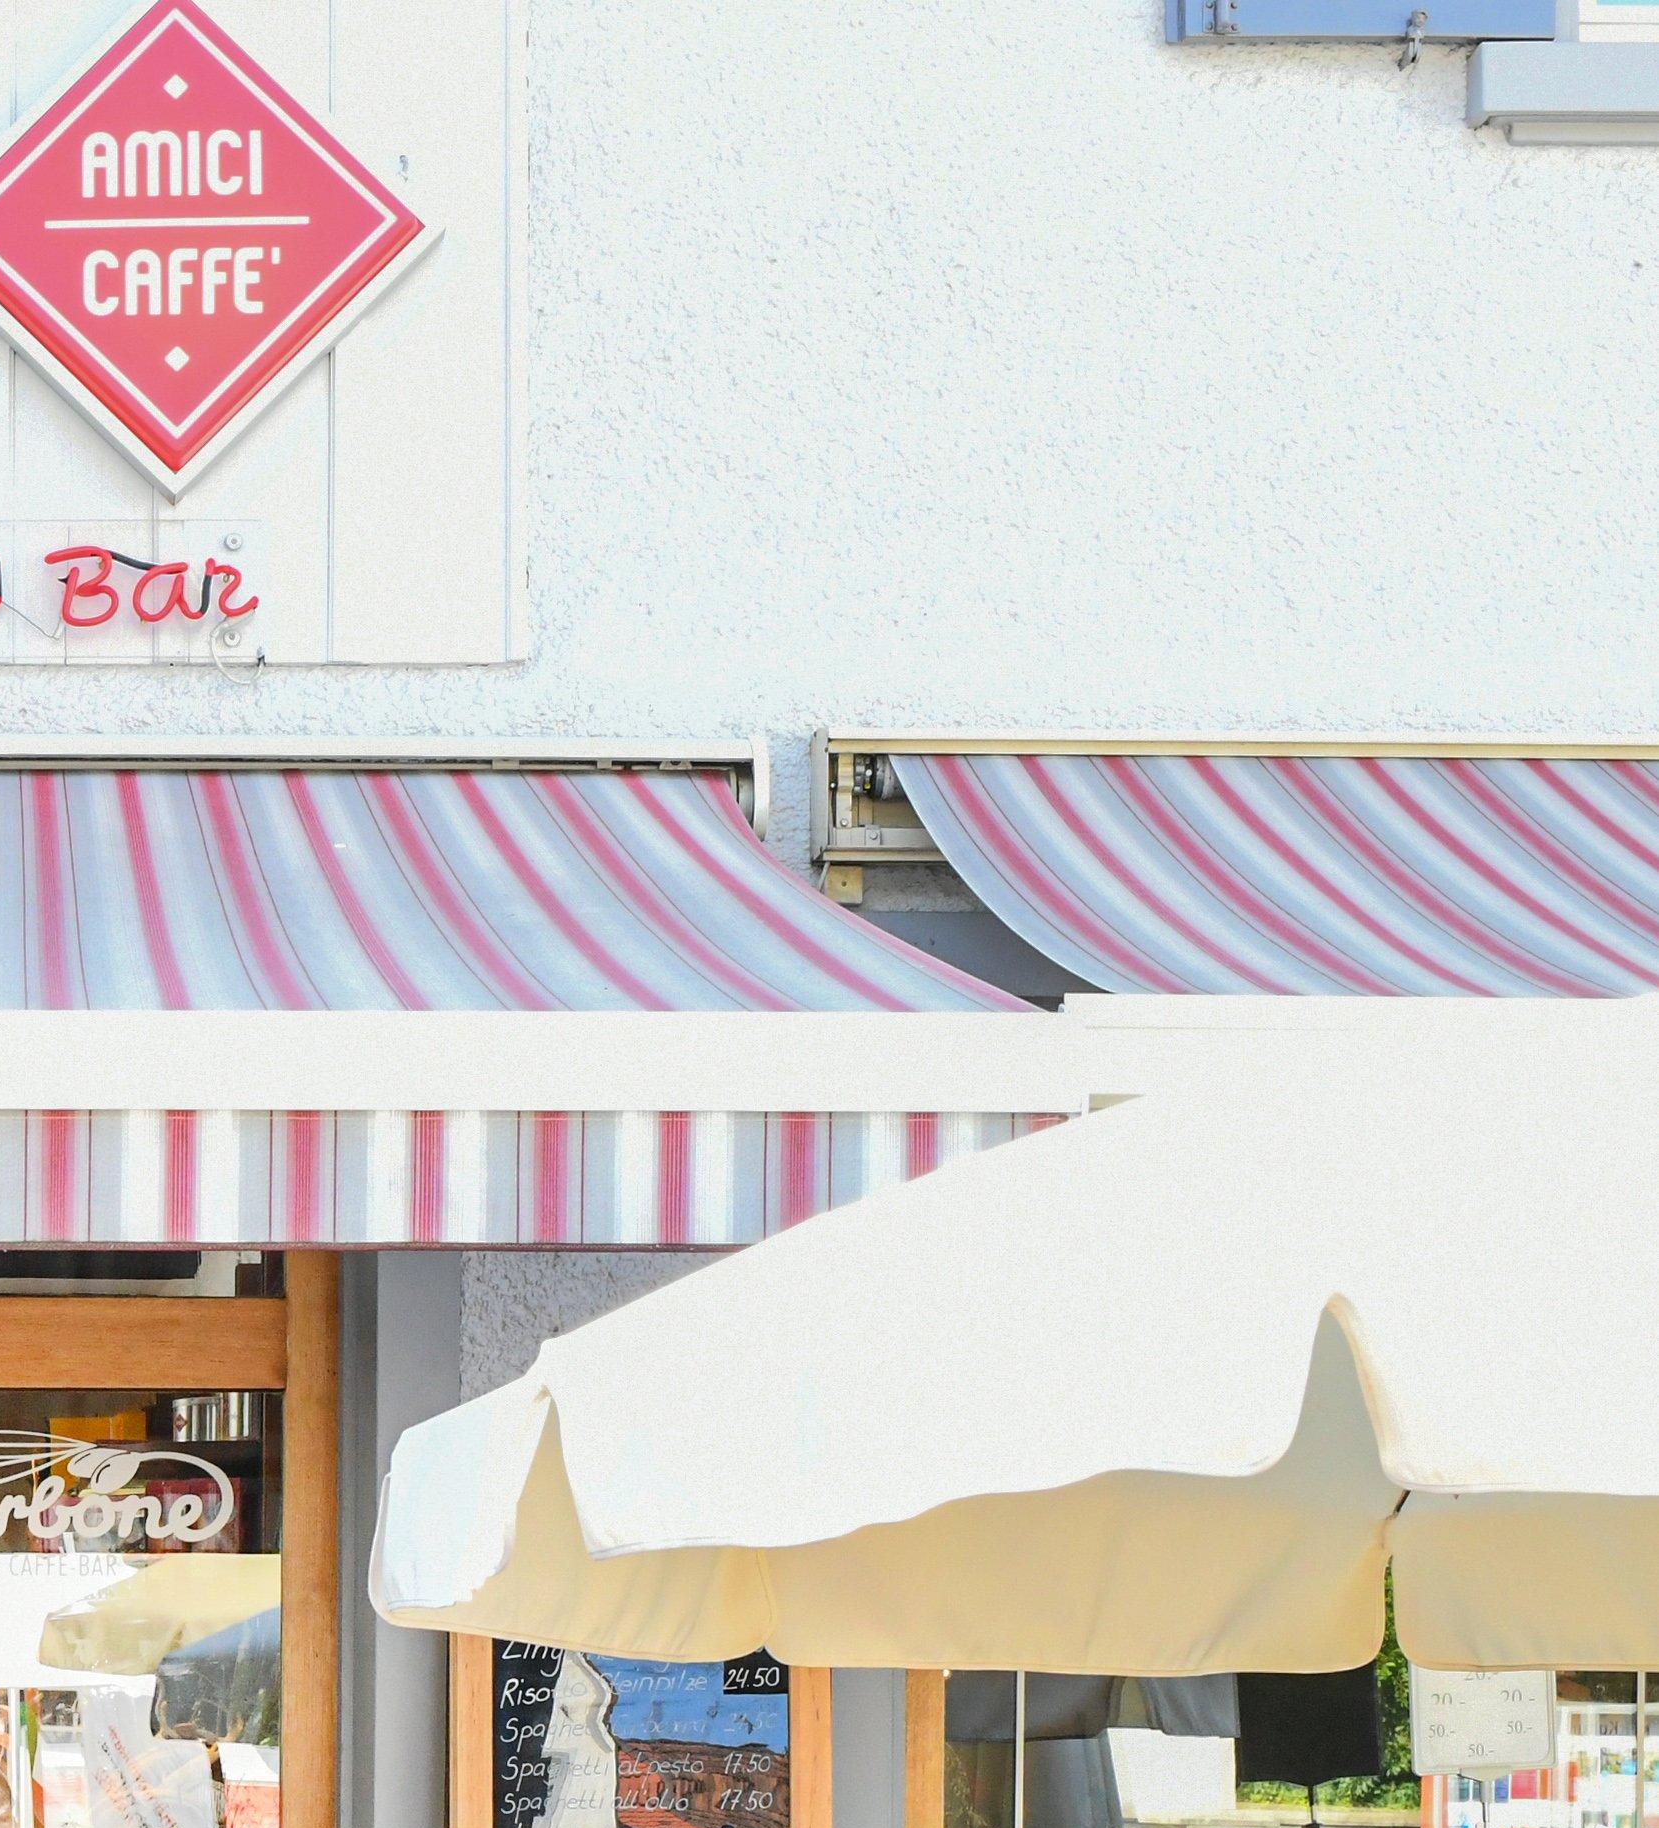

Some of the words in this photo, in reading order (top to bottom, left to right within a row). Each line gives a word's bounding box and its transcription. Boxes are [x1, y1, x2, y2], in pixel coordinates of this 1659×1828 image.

[81, 129, 263, 198] AMICI
[82, 246, 282, 316] CAFFE'
[44, 546, 260, 627] Bar
[723, 1665, 781, 1691] 24.50
[501, 1753, 609, 1791] Spagetti
[643, 1753, 705, 1789] pesto
[722, 1753, 773, 1775] 17.50
[500, 1789, 605, 1824] Spagetti
[719, 1789, 775, 1812] 17.50
